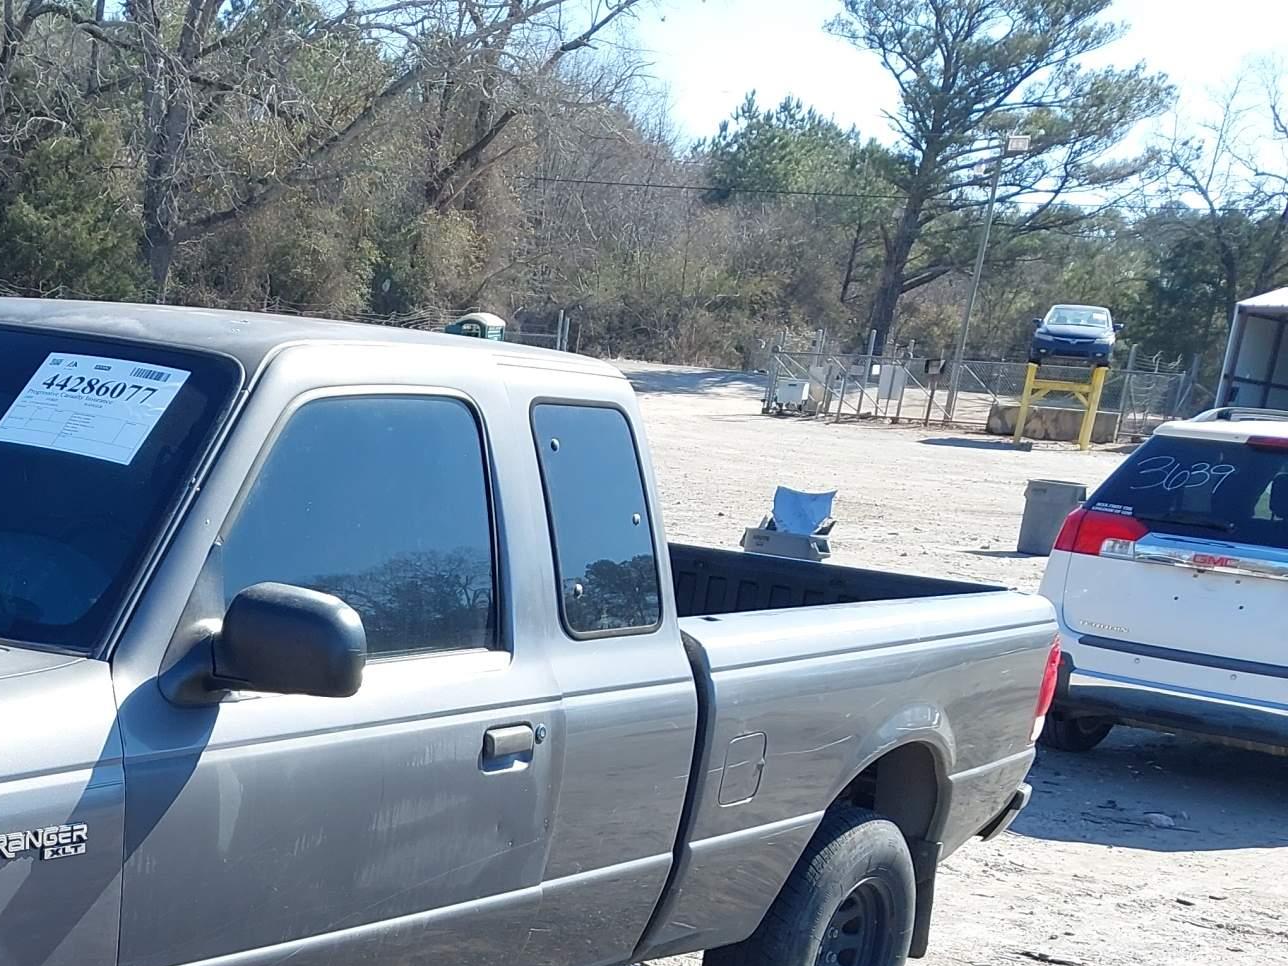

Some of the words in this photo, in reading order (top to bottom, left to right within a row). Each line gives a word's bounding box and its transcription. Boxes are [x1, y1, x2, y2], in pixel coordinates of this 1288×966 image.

[27, 388, 59, 397] Progressive
[59, 391, 84, 401] Casualty
[85, 395, 114, 405] Insurance
[42, 373, 158, 405] 44286077
[1130, 455, 1237, 494] 3639
[1193, 553, 1240, 568] GMC
[47, 845, 84, 859] XLT
